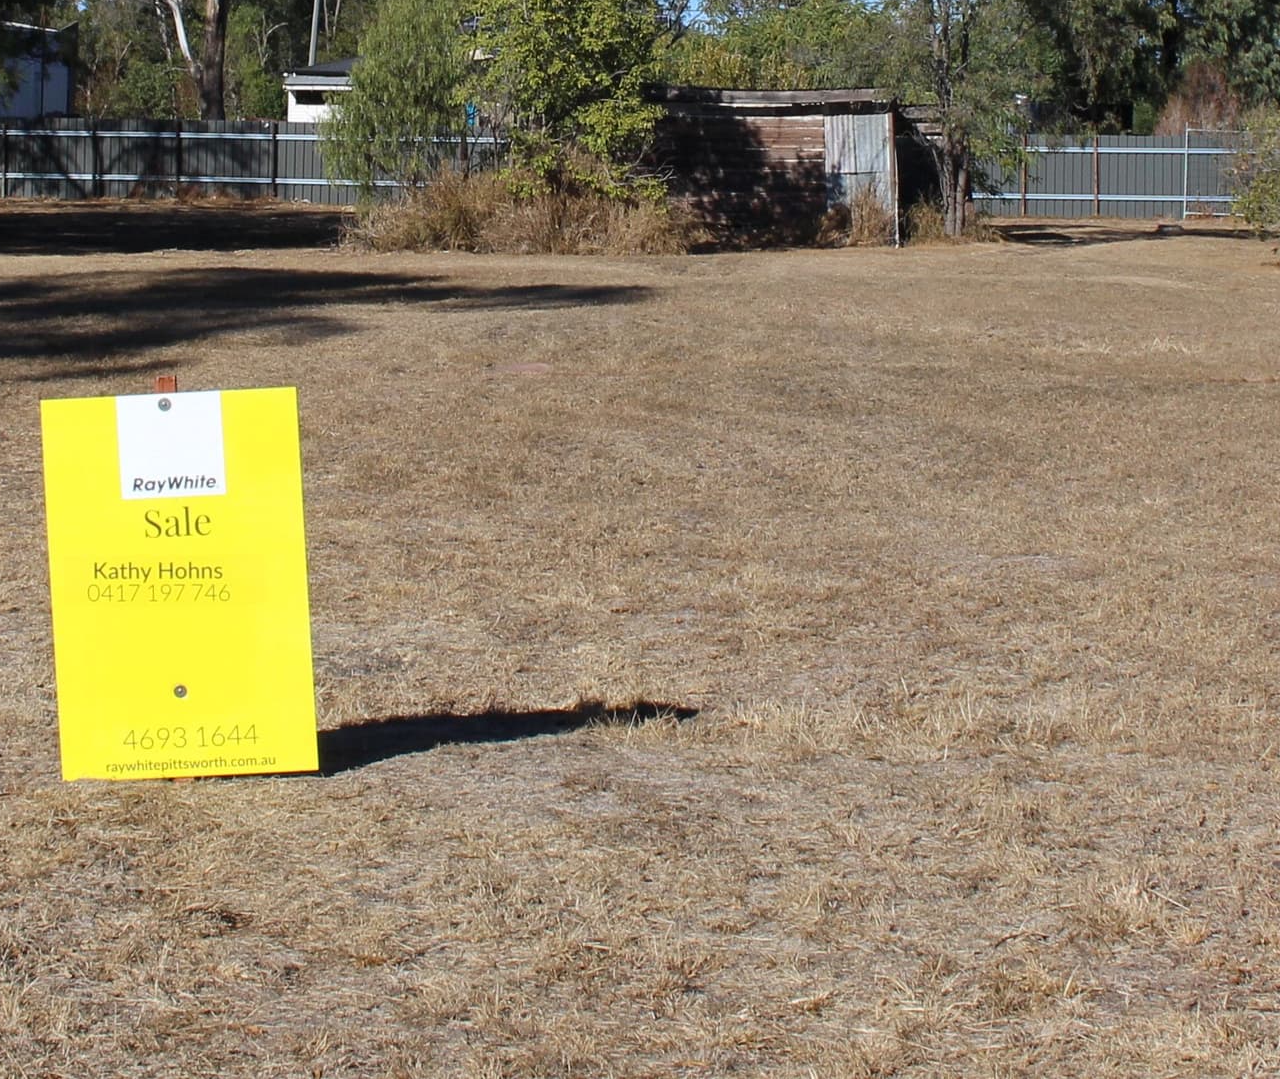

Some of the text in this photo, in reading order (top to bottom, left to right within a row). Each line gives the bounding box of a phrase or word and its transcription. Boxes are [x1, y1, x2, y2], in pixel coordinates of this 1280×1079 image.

[144, 506, 212, 539] Sale
[93, 561, 223, 583] Kathy Hohns
[87, 583, 231, 602] 0417 197 746
[123, 724, 259, 750] 4693 1644
[106, 756, 276, 774] raywhitepittsworth.com.au
